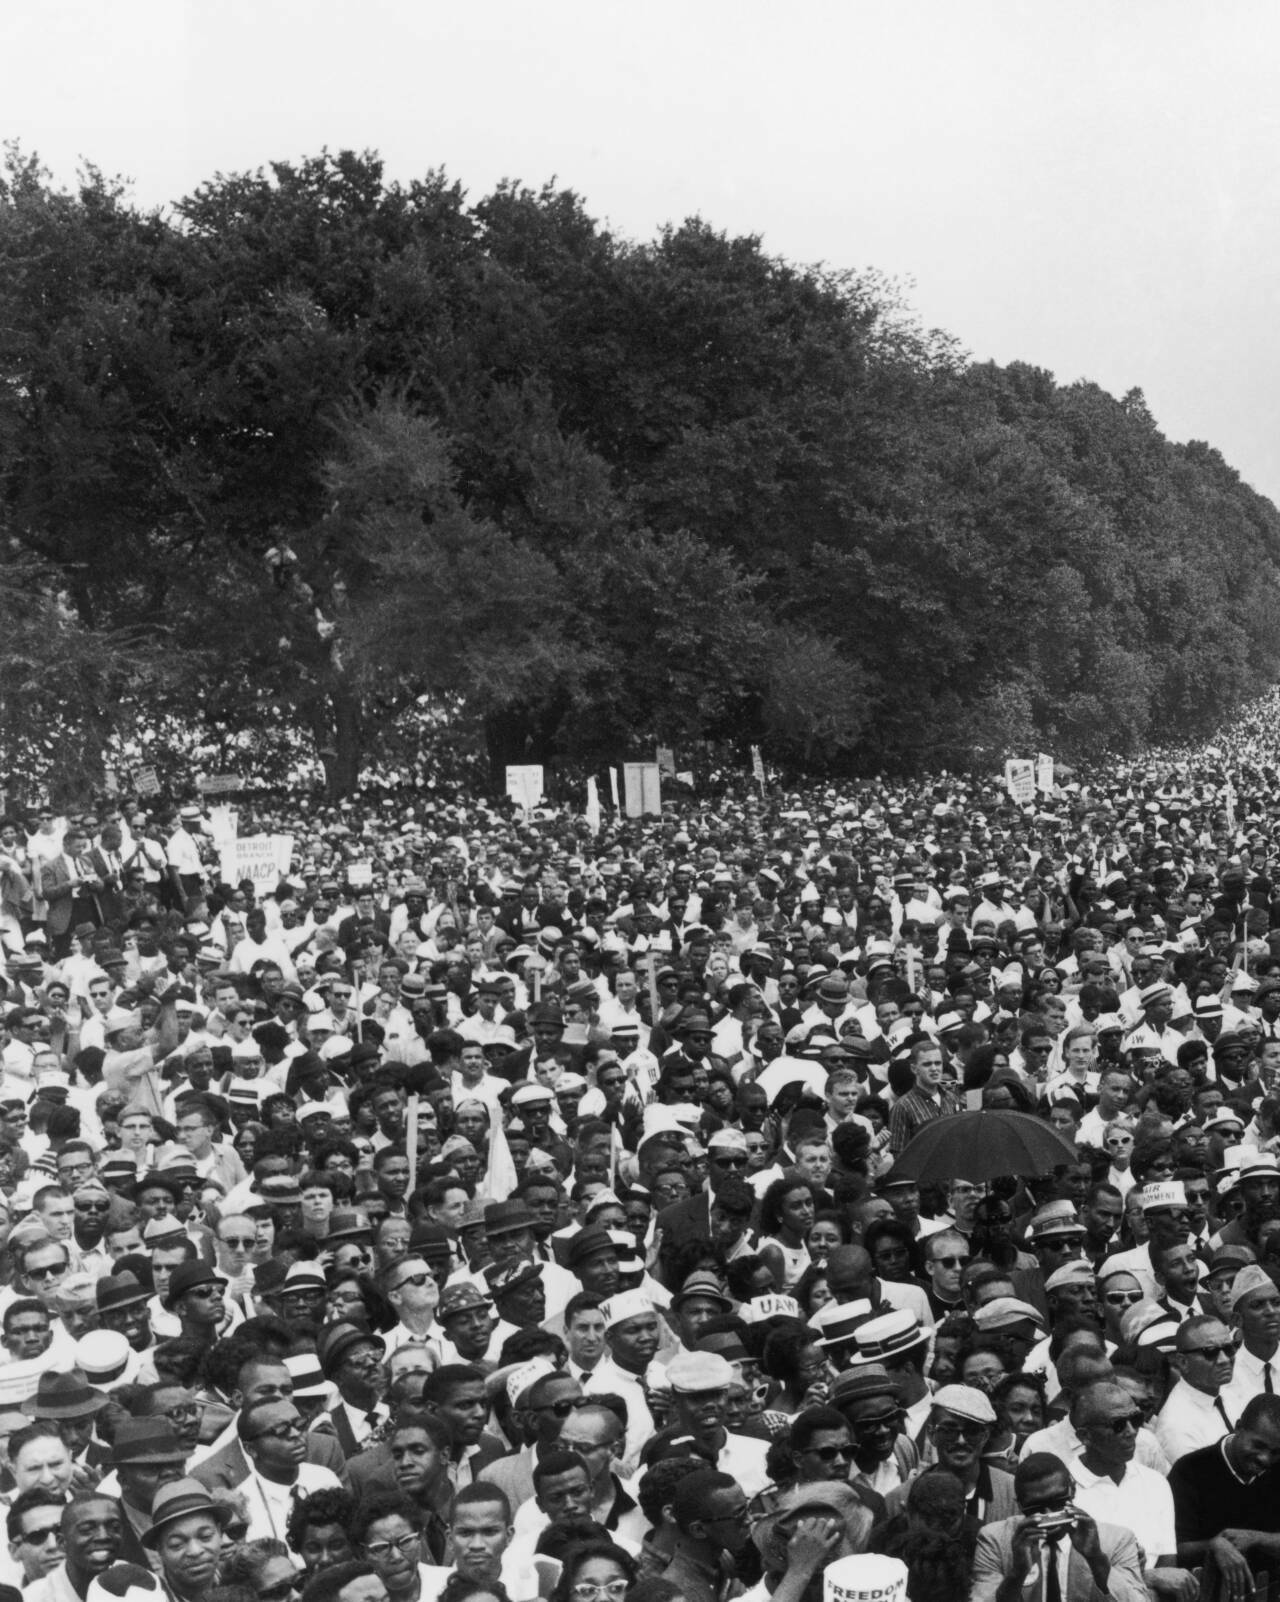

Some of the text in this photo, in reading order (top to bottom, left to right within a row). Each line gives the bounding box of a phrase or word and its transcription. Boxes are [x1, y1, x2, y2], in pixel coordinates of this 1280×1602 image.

[236, 862, 275, 881] NAACP
[1144, 1184, 1161, 1194] AIR
[760, 1301, 796, 1314] UAW
[827, 1577, 904, 1601] FREEDOM
